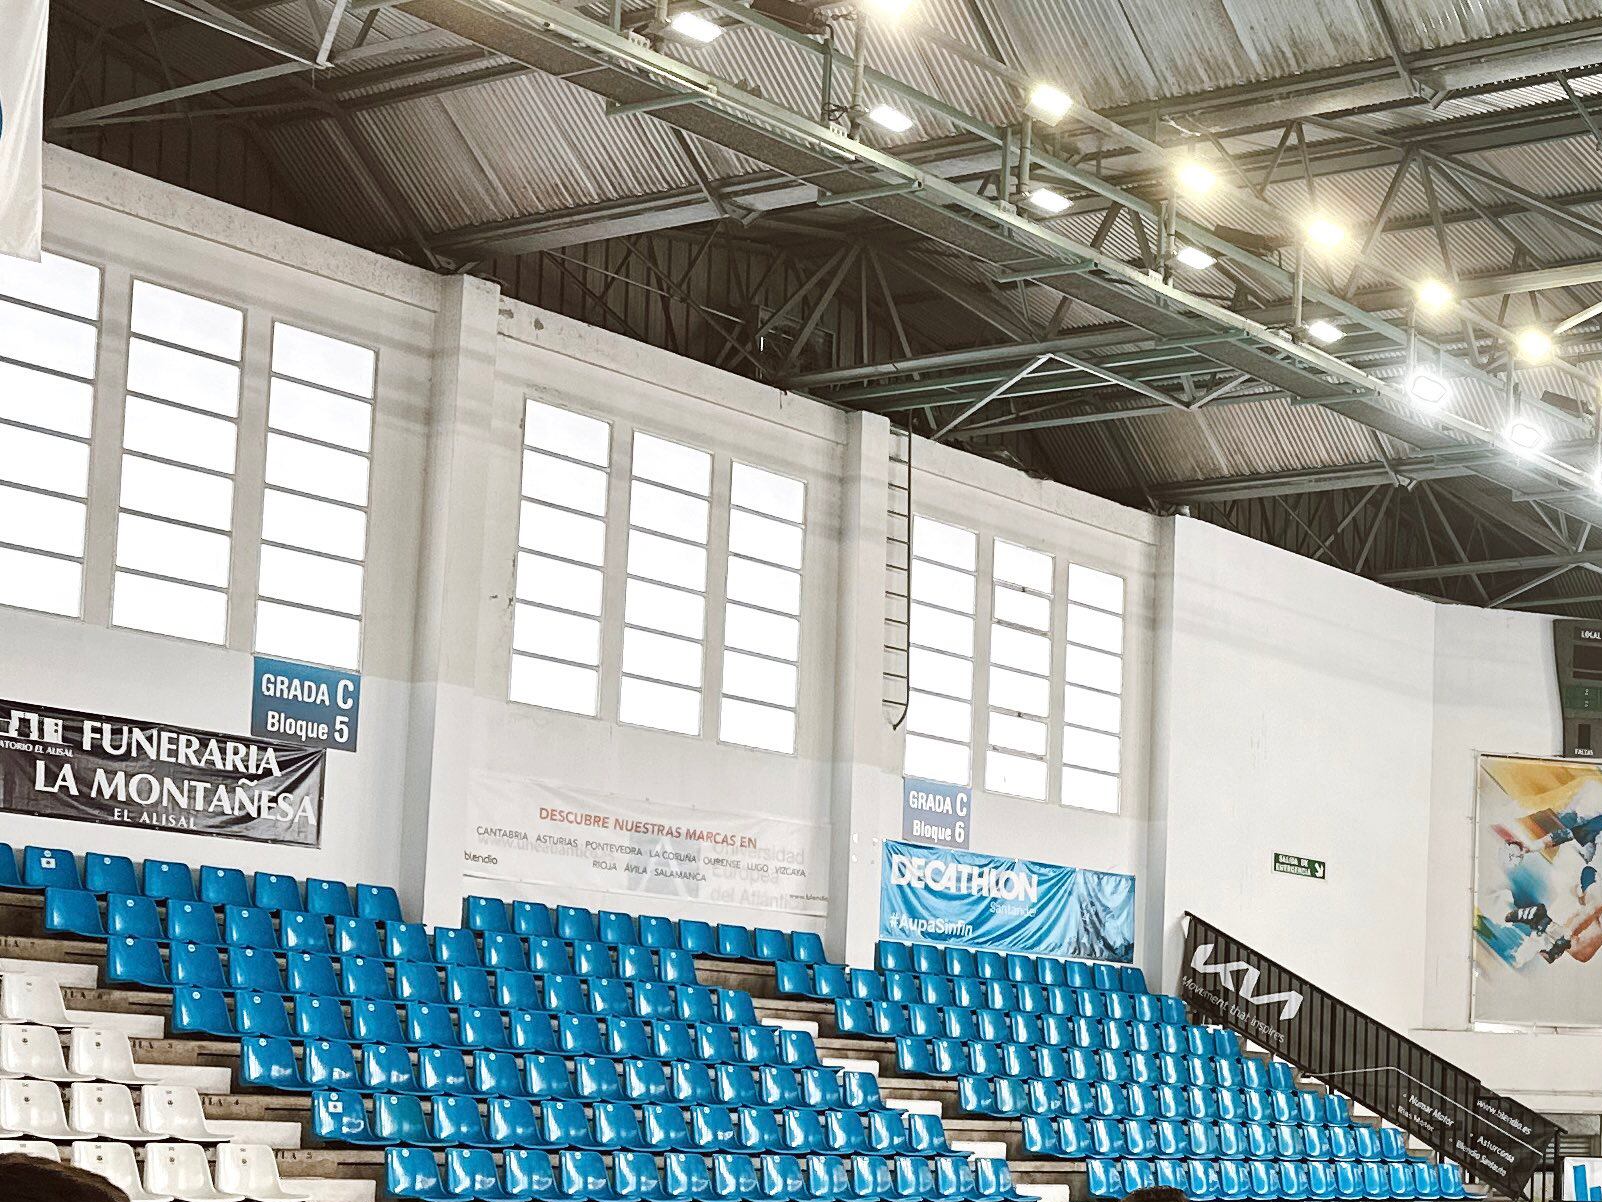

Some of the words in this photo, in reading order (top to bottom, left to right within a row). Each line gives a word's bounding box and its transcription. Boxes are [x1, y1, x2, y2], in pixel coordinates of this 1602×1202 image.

[261, 673, 330, 706] GRADA
[336, 679, 355, 710] C
[266, 710, 329, 742] Bloque
[333, 717, 349, 743] 5
[81, 719, 282, 777] FUNERARIA
[34, 760, 79, 796] LA
[90, 768, 317, 826] MONTAÑESA
[909, 790, 952, 815] GRADA
[956, 793, 968, 816] C
[113, 808, 132, 822] EL
[138, 812, 198, 829] ALISAL
[539, 807, 610, 828] DESCUBRE
[613, 817, 682, 839] NUESTRAS
[685, 828, 736, 847] MARCAS
[740, 836, 758, 849] EN
[912, 819, 951, 843] Bloque
[955, 821, 965, 843] 6
[476, 825, 528, 840] CANTABRIA
[535, 834, 578, 848] ASTURIAS
[585, 840, 643, 857] PONTEVEDRA
[747, 862, 769, 873] LUGO
[592, 860, 618, 871] RIOJA
[654, 867, 706, 882] SALAMANCA
[890, 853, 1038, 903] DECATHLON
[1182, 976, 1229, 1012] Movement
[1229, 1004, 1250, 1023] that
[1250, 1015, 1285, 1043] inspires
